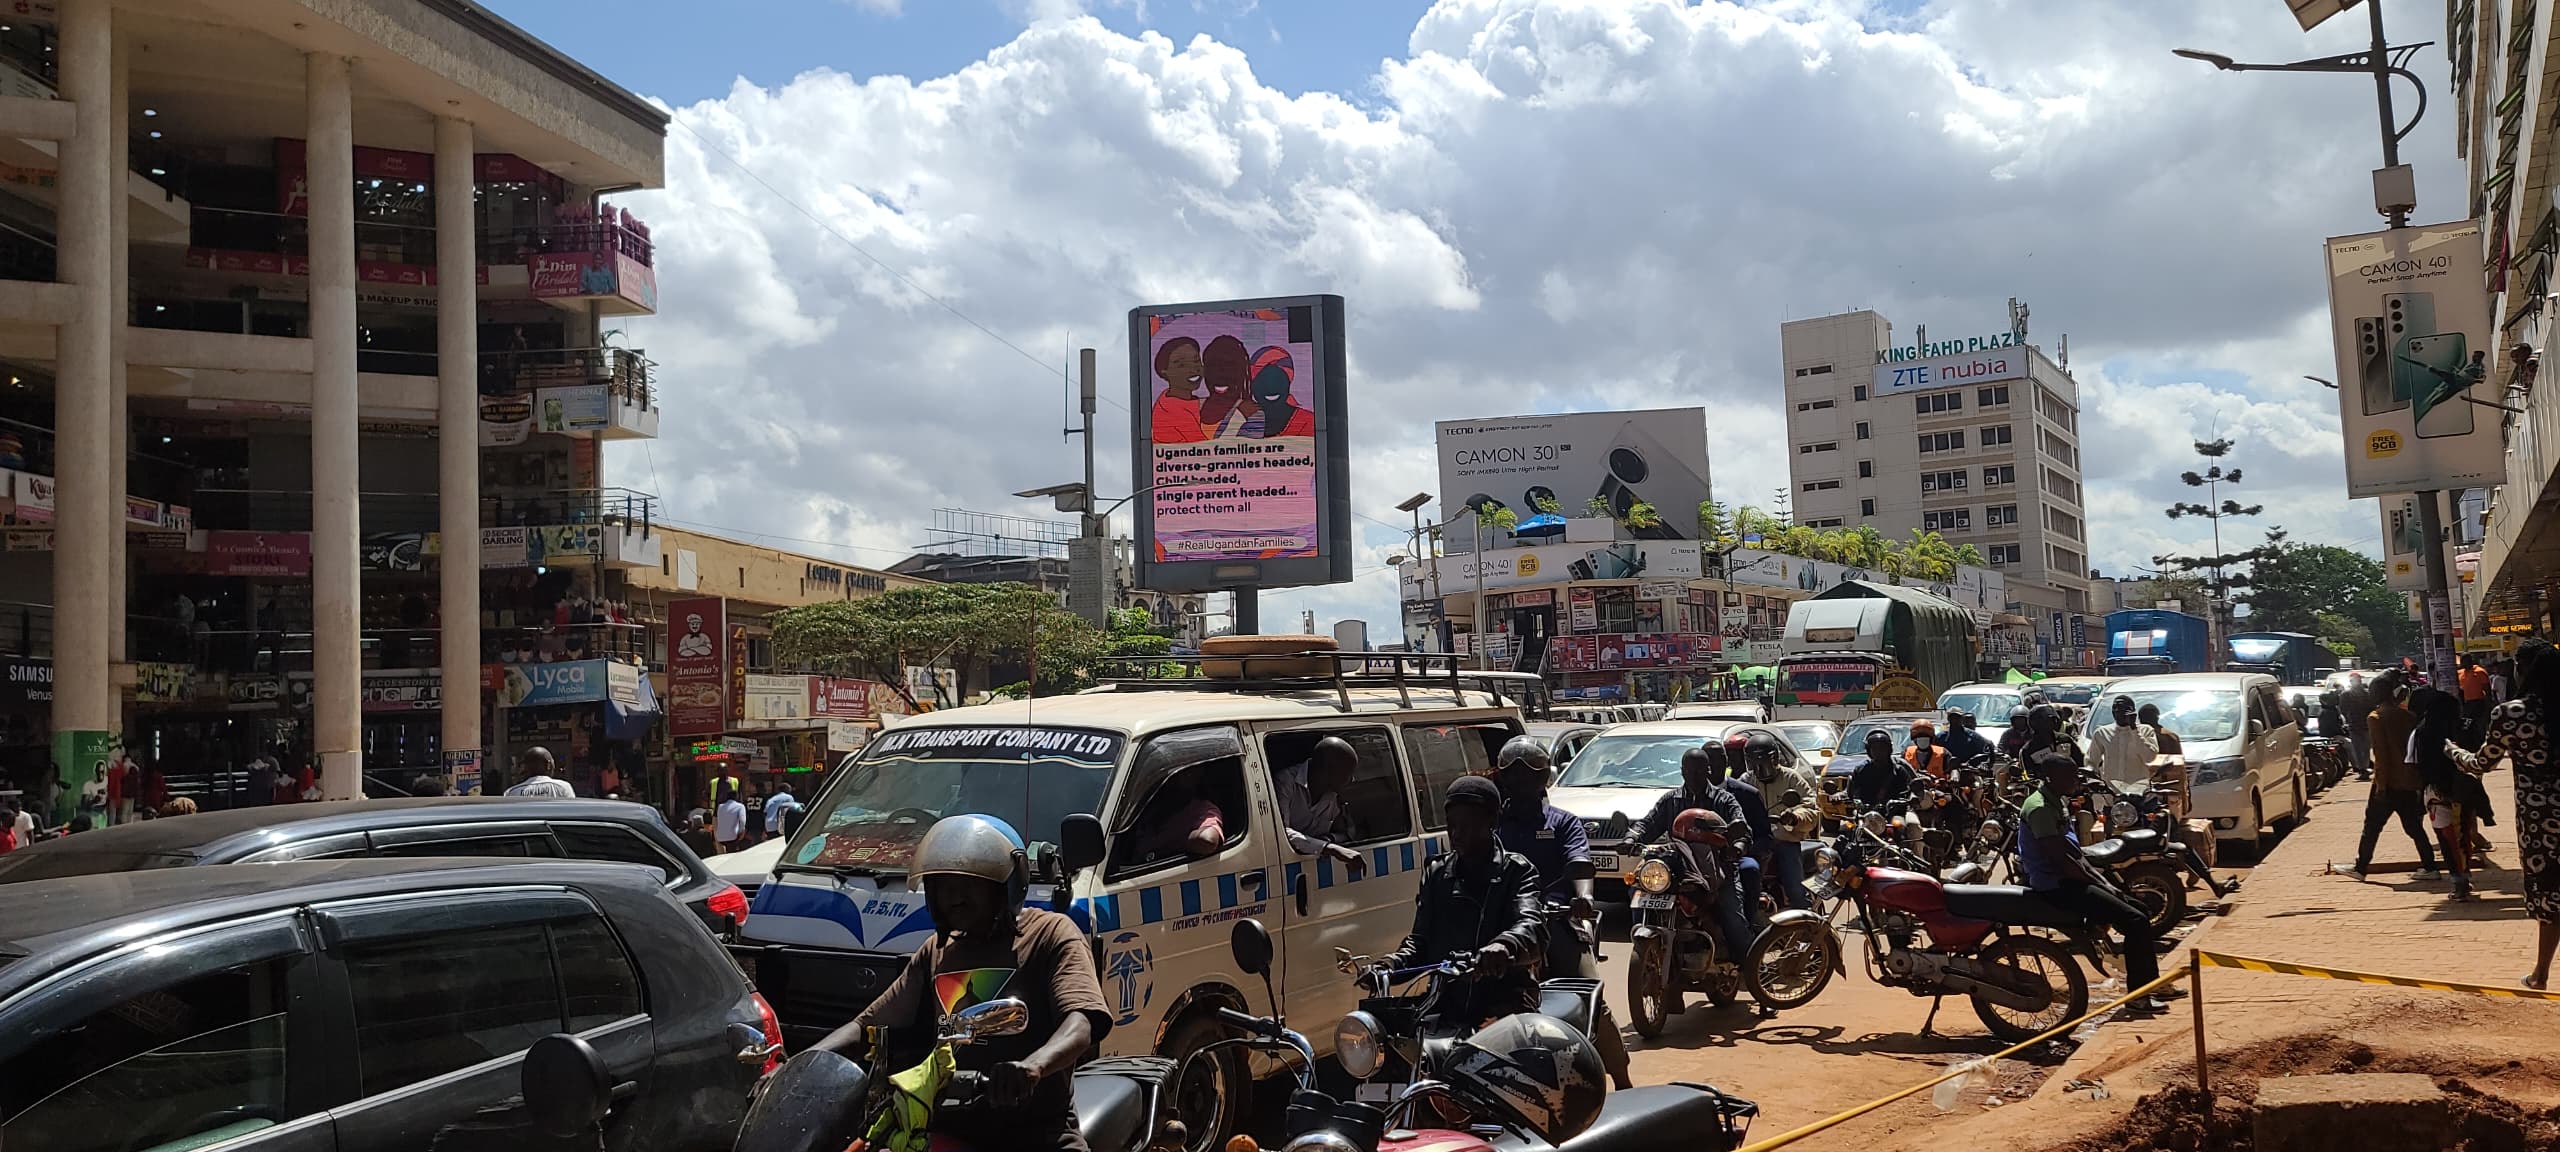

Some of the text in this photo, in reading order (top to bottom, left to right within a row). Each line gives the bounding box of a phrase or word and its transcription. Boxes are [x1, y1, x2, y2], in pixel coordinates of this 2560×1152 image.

[549, 261, 577, 274] Dim
[2360, 256, 2447, 277] CAMON 40
[539, 273, 578, 287] Bridals
[2367, 270, 2447, 285] Perfect Snap Anytime
[367, 296, 411, 304] MAKEUP
[1877, 345, 1916, 364] KING
[1922, 339, 1964, 358] FAHD
[1893, 358, 2007, 387] ZTE nubia
[1445, 427, 1474, 435] TECNO
[2372, 435, 2395, 443] FREE
[1155, 444, 1285, 461] Ugandan families are
[2372, 442, 2397, 450] 9GB
[1455, 447, 1526, 465] CAMON
[1533, 445, 1554, 461] 30
[1155, 456, 1314, 473] diverse-grannies headed,
[29, 478, 55, 500] Kwa
[1156, 490, 1194, 503] single
[1196, 488, 1237, 502] parent
[1157, 502, 1251, 519] protect them all
[482, 537, 524, 545] DARLING
[1178, 535, 1295, 551] #RealUgandanFamilies
[533, 665, 585, 689] Lyca
[679, 664, 719, 676] Antonio's
[734, 626, 746, 718] Antonio
[557, 685, 585, 695] Mobile
[832, 685, 865, 701] Antonio's
[907, 730, 998, 749] TRANSPORT
[996, 730, 1078, 751] COMPANY
[1076, 737, 1112, 755] LTD
[747, 797, 762, 810] 23
